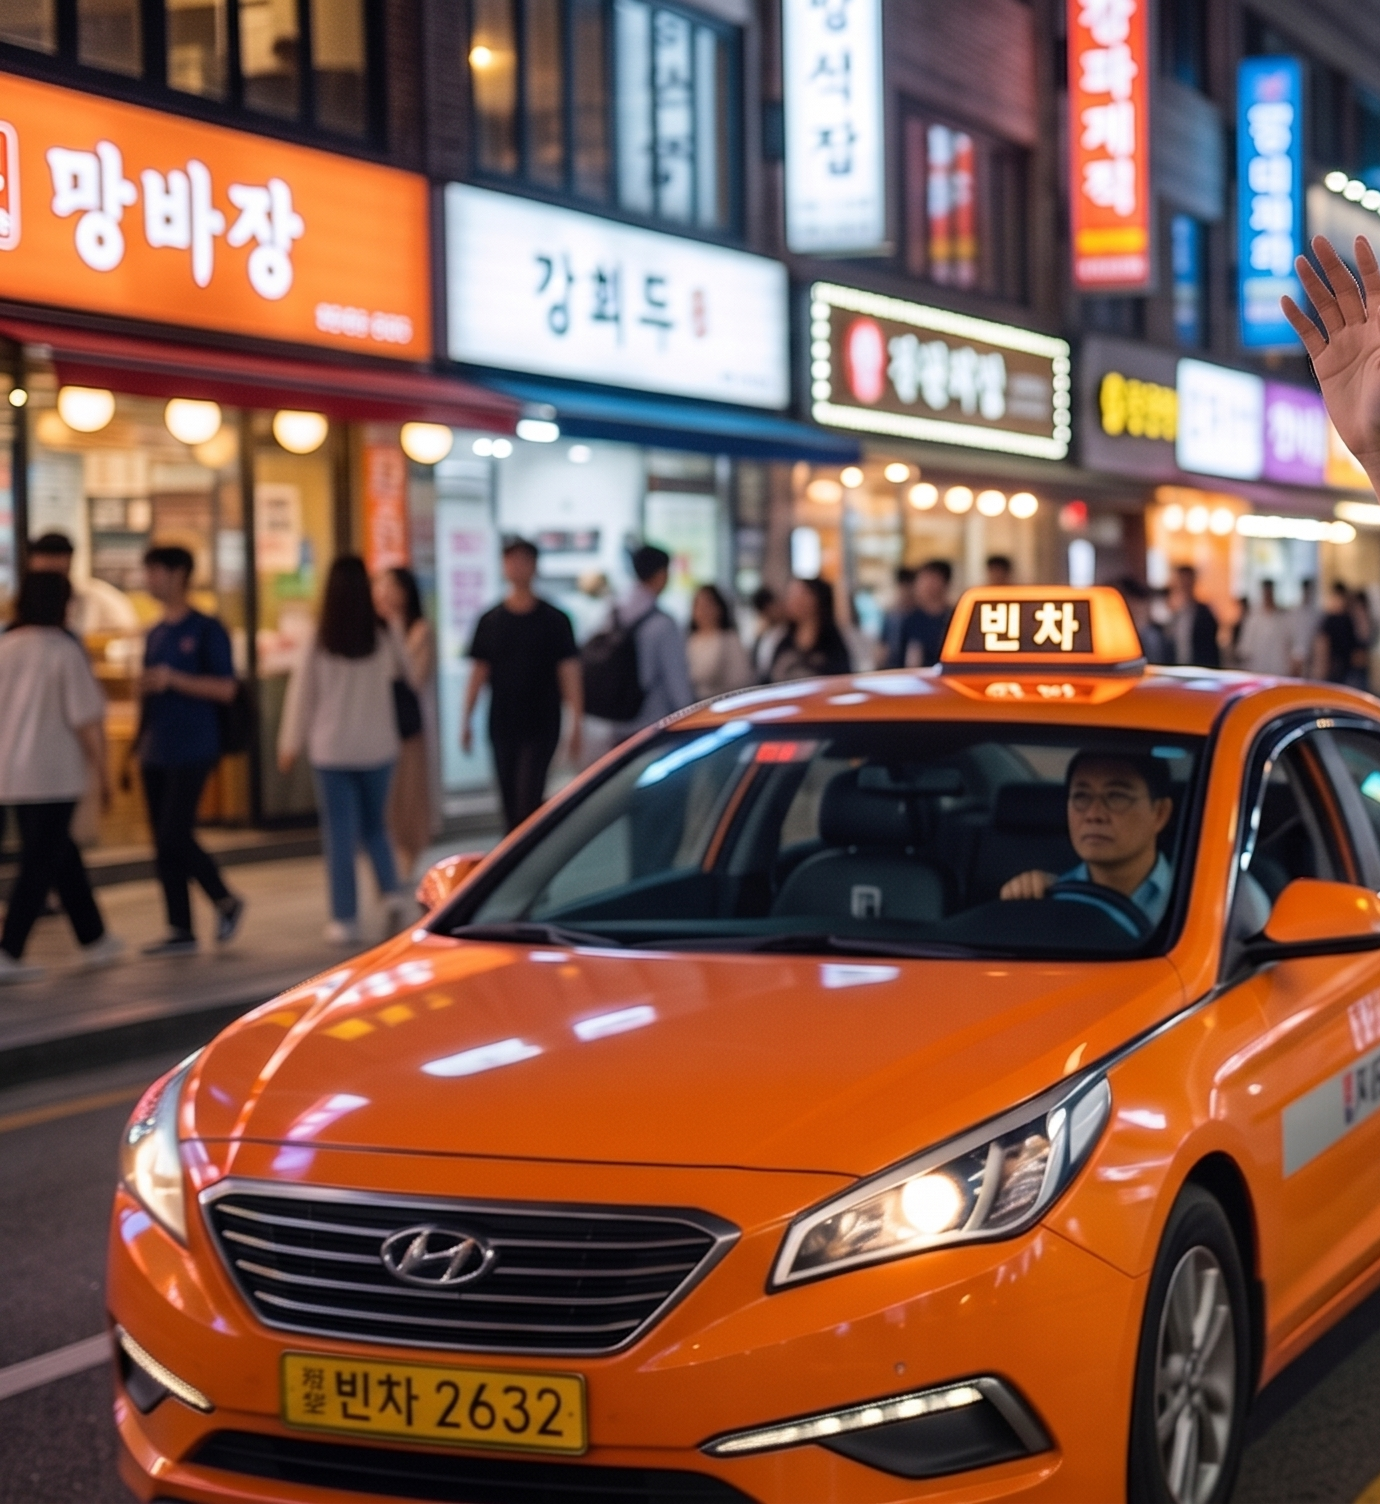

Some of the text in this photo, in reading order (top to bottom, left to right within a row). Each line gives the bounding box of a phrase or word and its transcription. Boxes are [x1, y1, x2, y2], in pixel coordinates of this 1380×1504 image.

[46, 140, 304, 300] 망바장
[334, 1370, 420, 1428] 빈차
[434, 1379, 565, 1438] 2632
